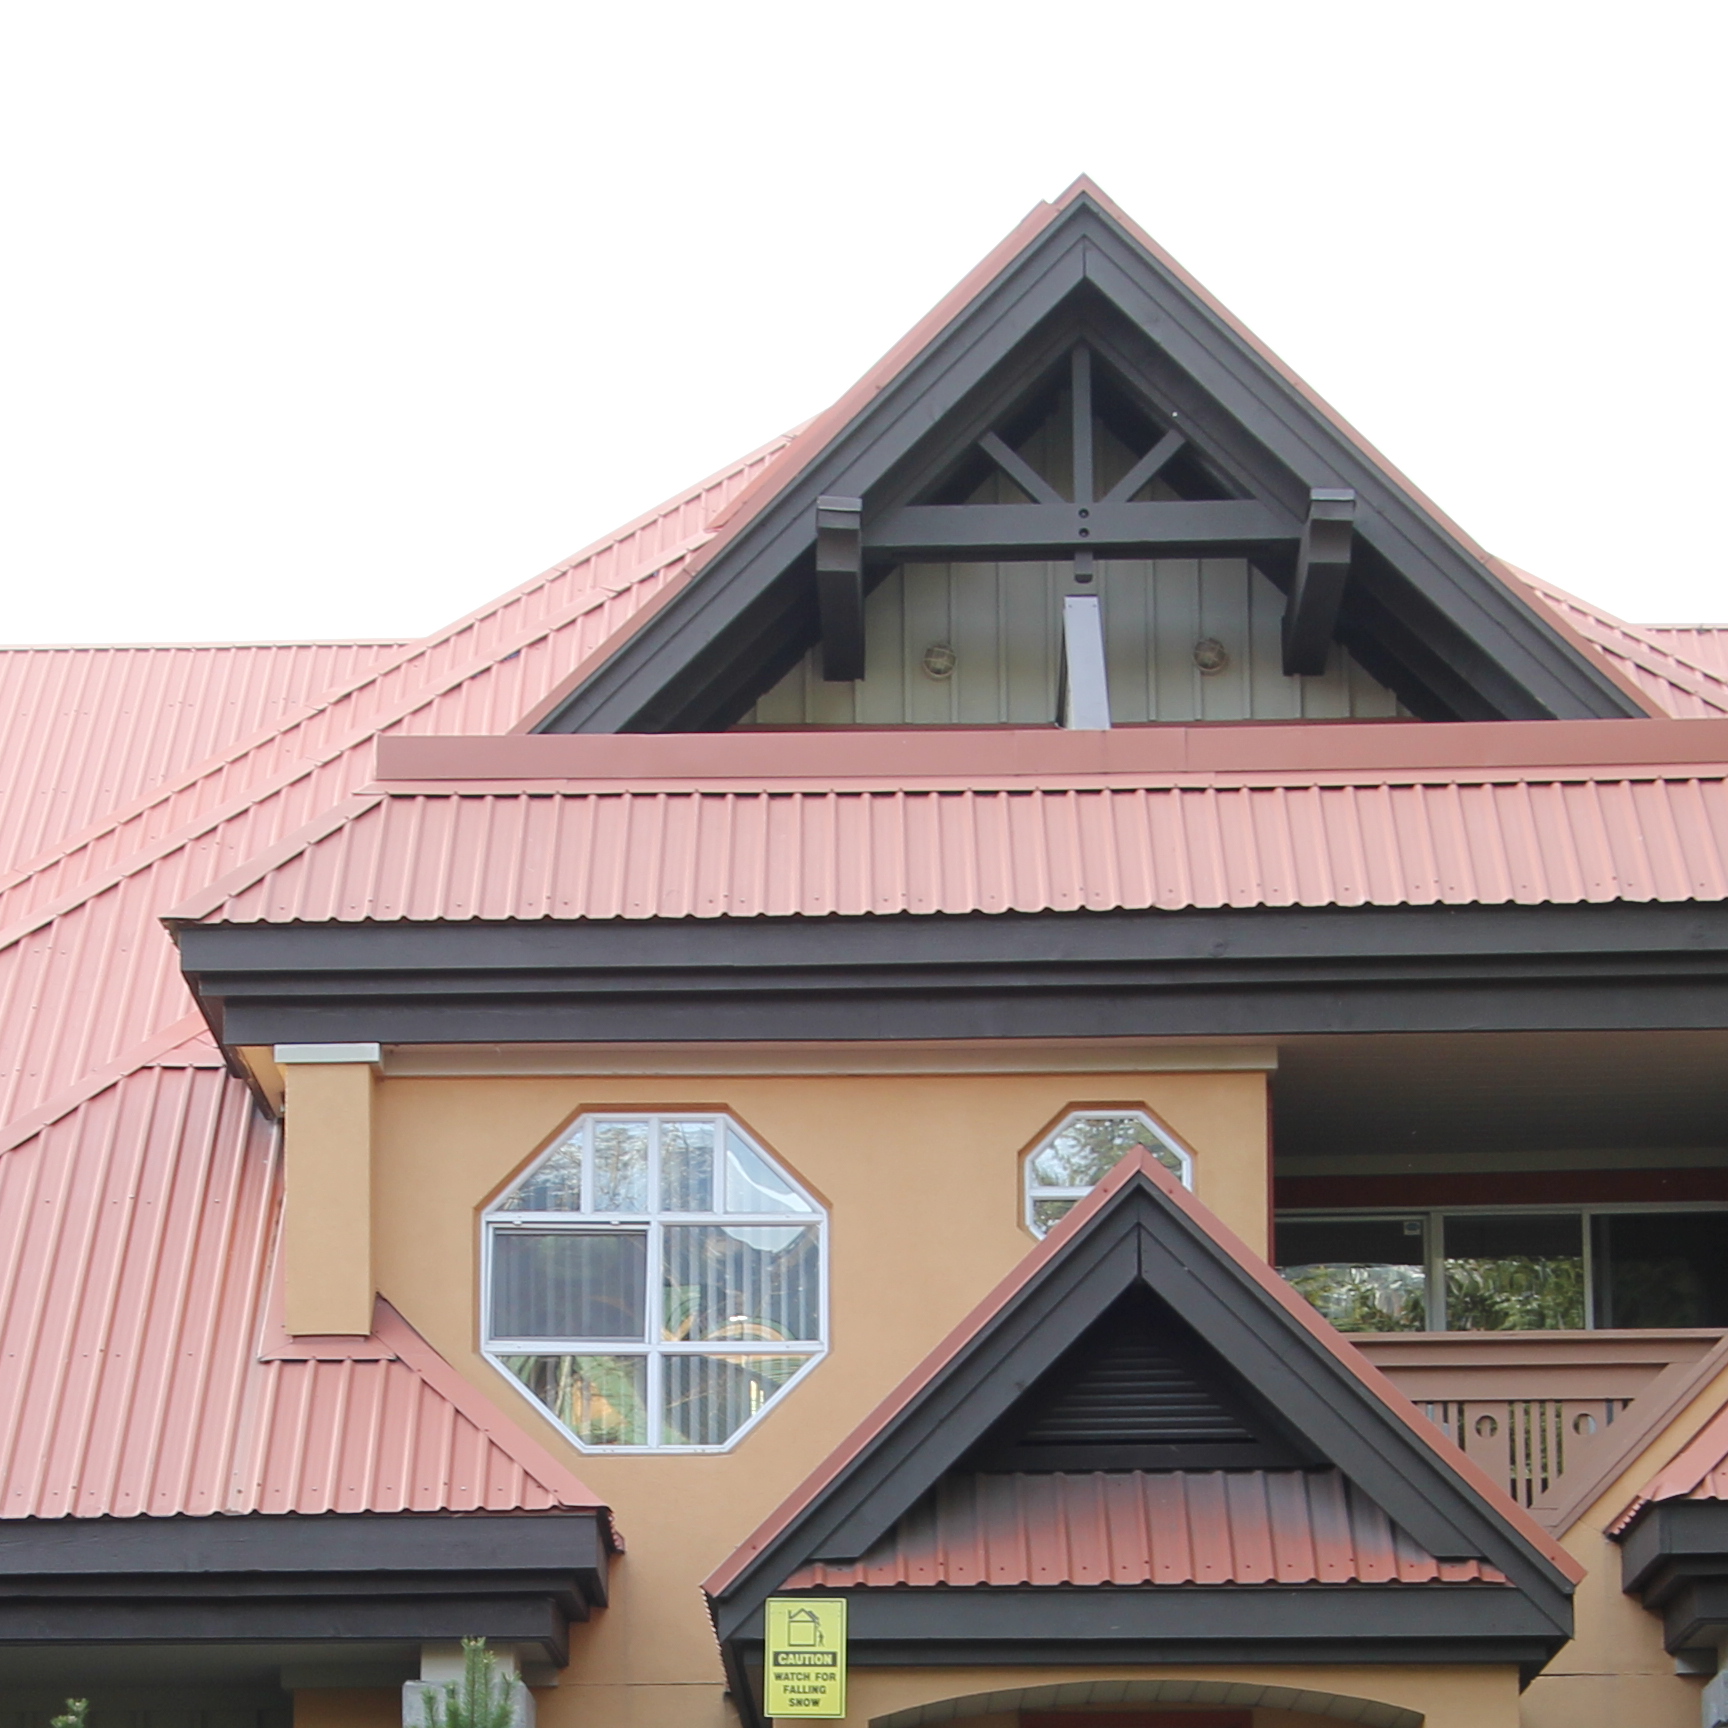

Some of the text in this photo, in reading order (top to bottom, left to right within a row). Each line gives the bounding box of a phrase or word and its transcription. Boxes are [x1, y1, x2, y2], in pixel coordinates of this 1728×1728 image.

[777, 1653, 833, 1665] CAUTION
[774, 1672, 837, 1682] WATCH FOR
[783, 1685, 826, 1695] FALLING
[789, 1698, 821, 1707] SNOW
